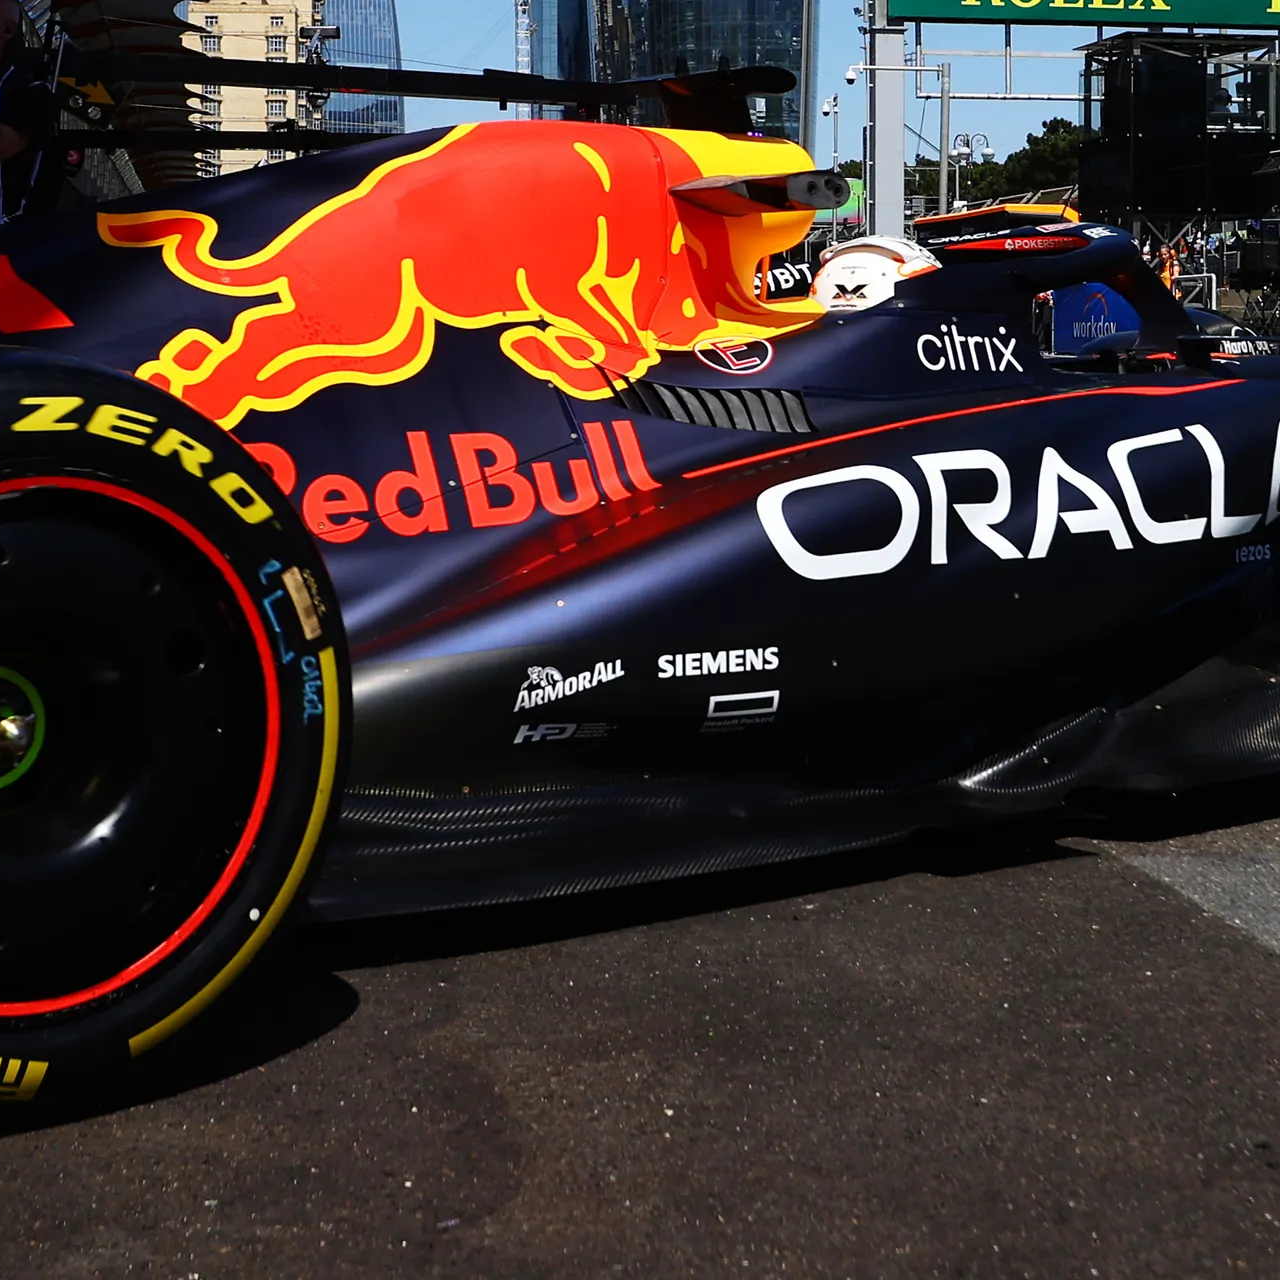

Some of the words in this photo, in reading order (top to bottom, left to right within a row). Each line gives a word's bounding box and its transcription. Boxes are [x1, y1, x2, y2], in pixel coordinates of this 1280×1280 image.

[927, 229, 1012, 244] ORACLE
[917, 315, 1024, 373] citrix
[8, 395, 276, 527] ZERO
[448, 419, 664, 529] Bull
[657, 646, 780, 680] SIEMENS
